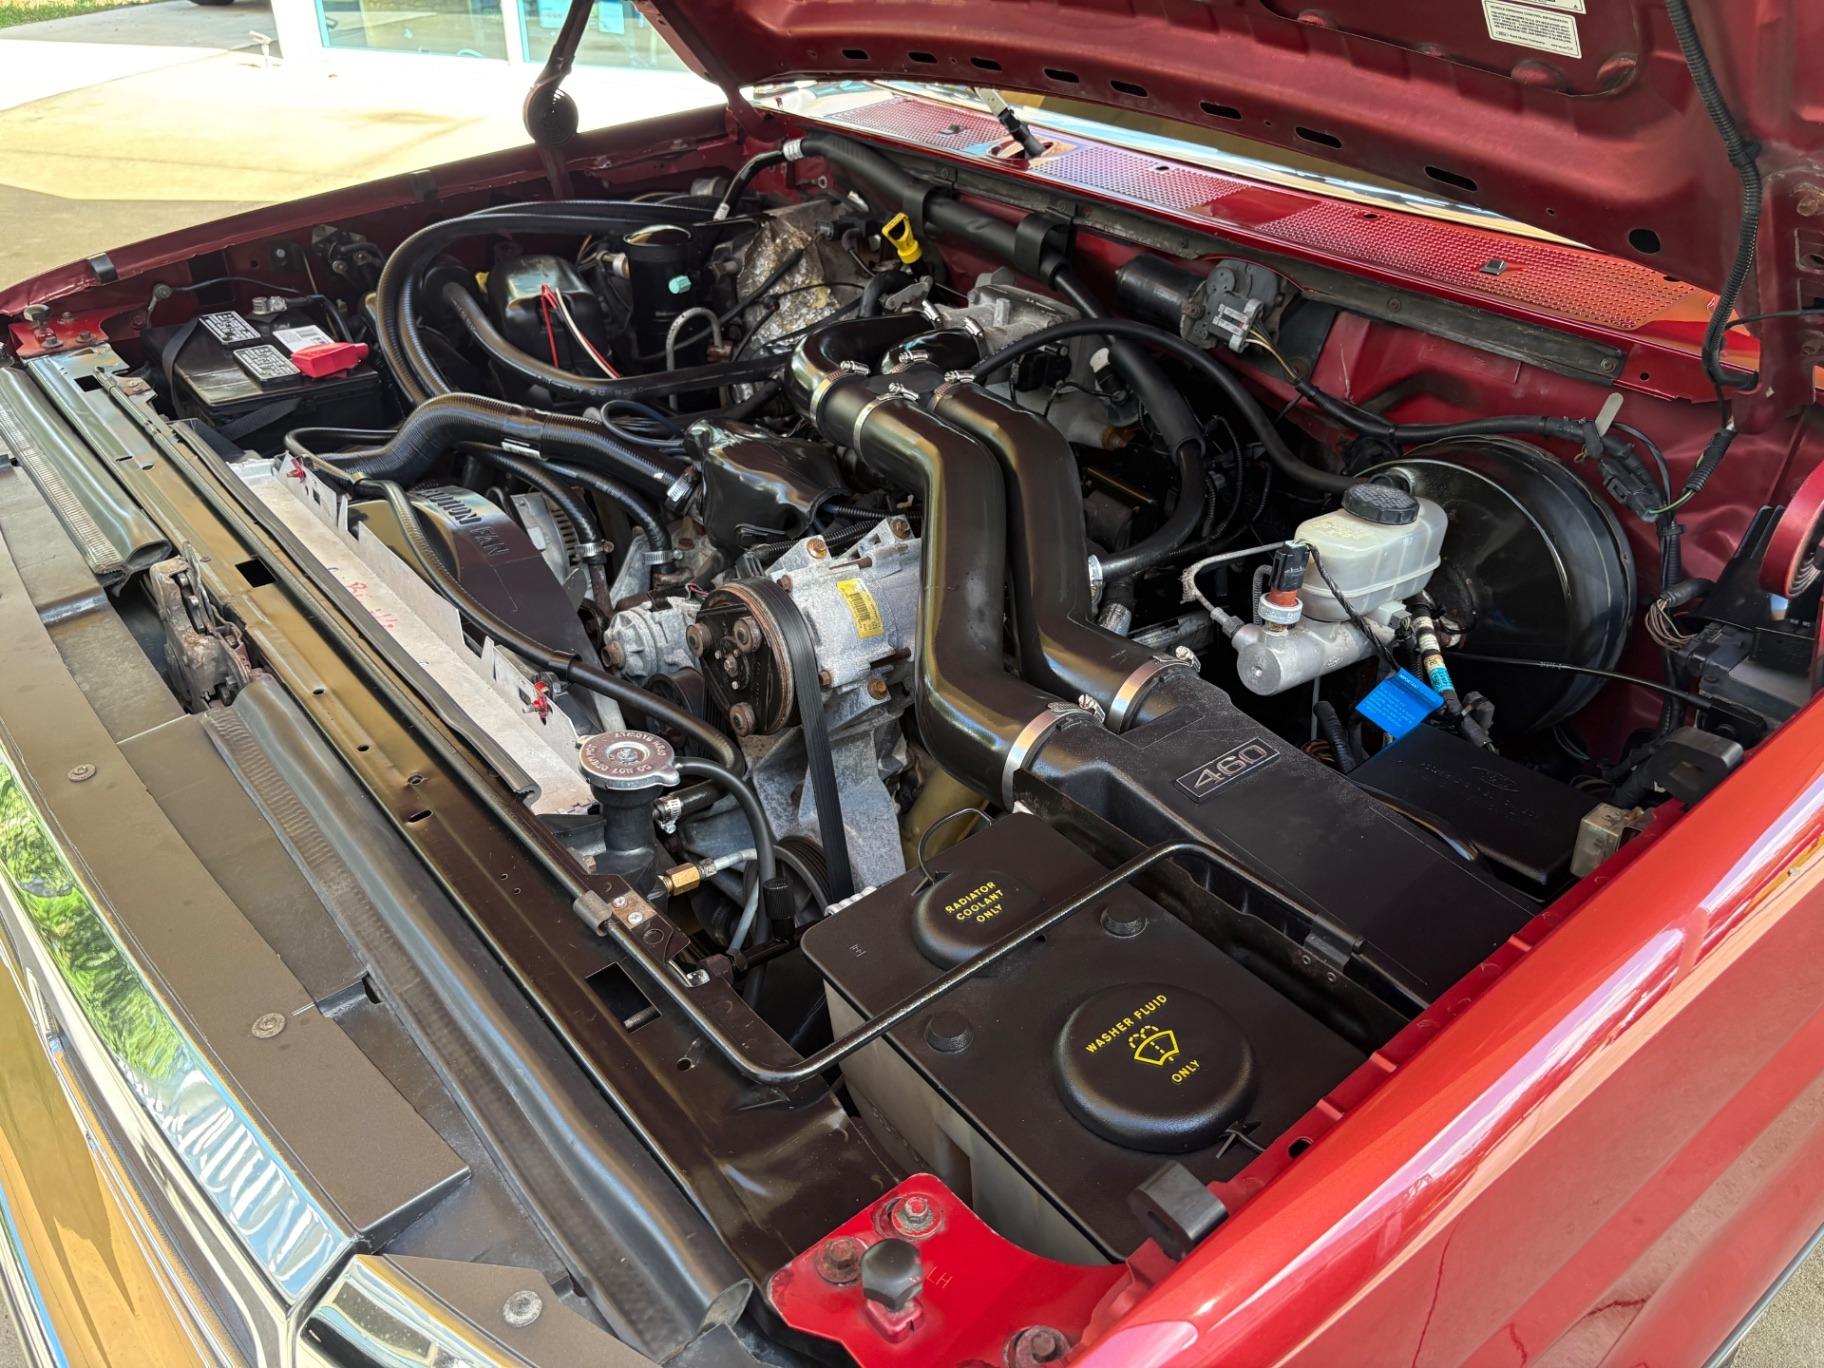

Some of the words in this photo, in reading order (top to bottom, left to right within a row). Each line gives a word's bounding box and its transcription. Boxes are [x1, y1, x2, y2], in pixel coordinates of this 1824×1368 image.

[415, 488, 482, 525] AUTION
[470, 526, 511, 556] FAN
[1194, 744, 1267, 789] 460
[945, 881, 996, 914] RADIATOR
[956, 889, 1004, 921] COOLANT
[976, 904, 1003, 923] ONLY
[1085, 1017, 1134, 1053] WASHER
[1133, 994, 1168, 1020] FLUID
[1171, 1059, 1200, 1083] ONLY
[926, 1266, 953, 1289] LH
